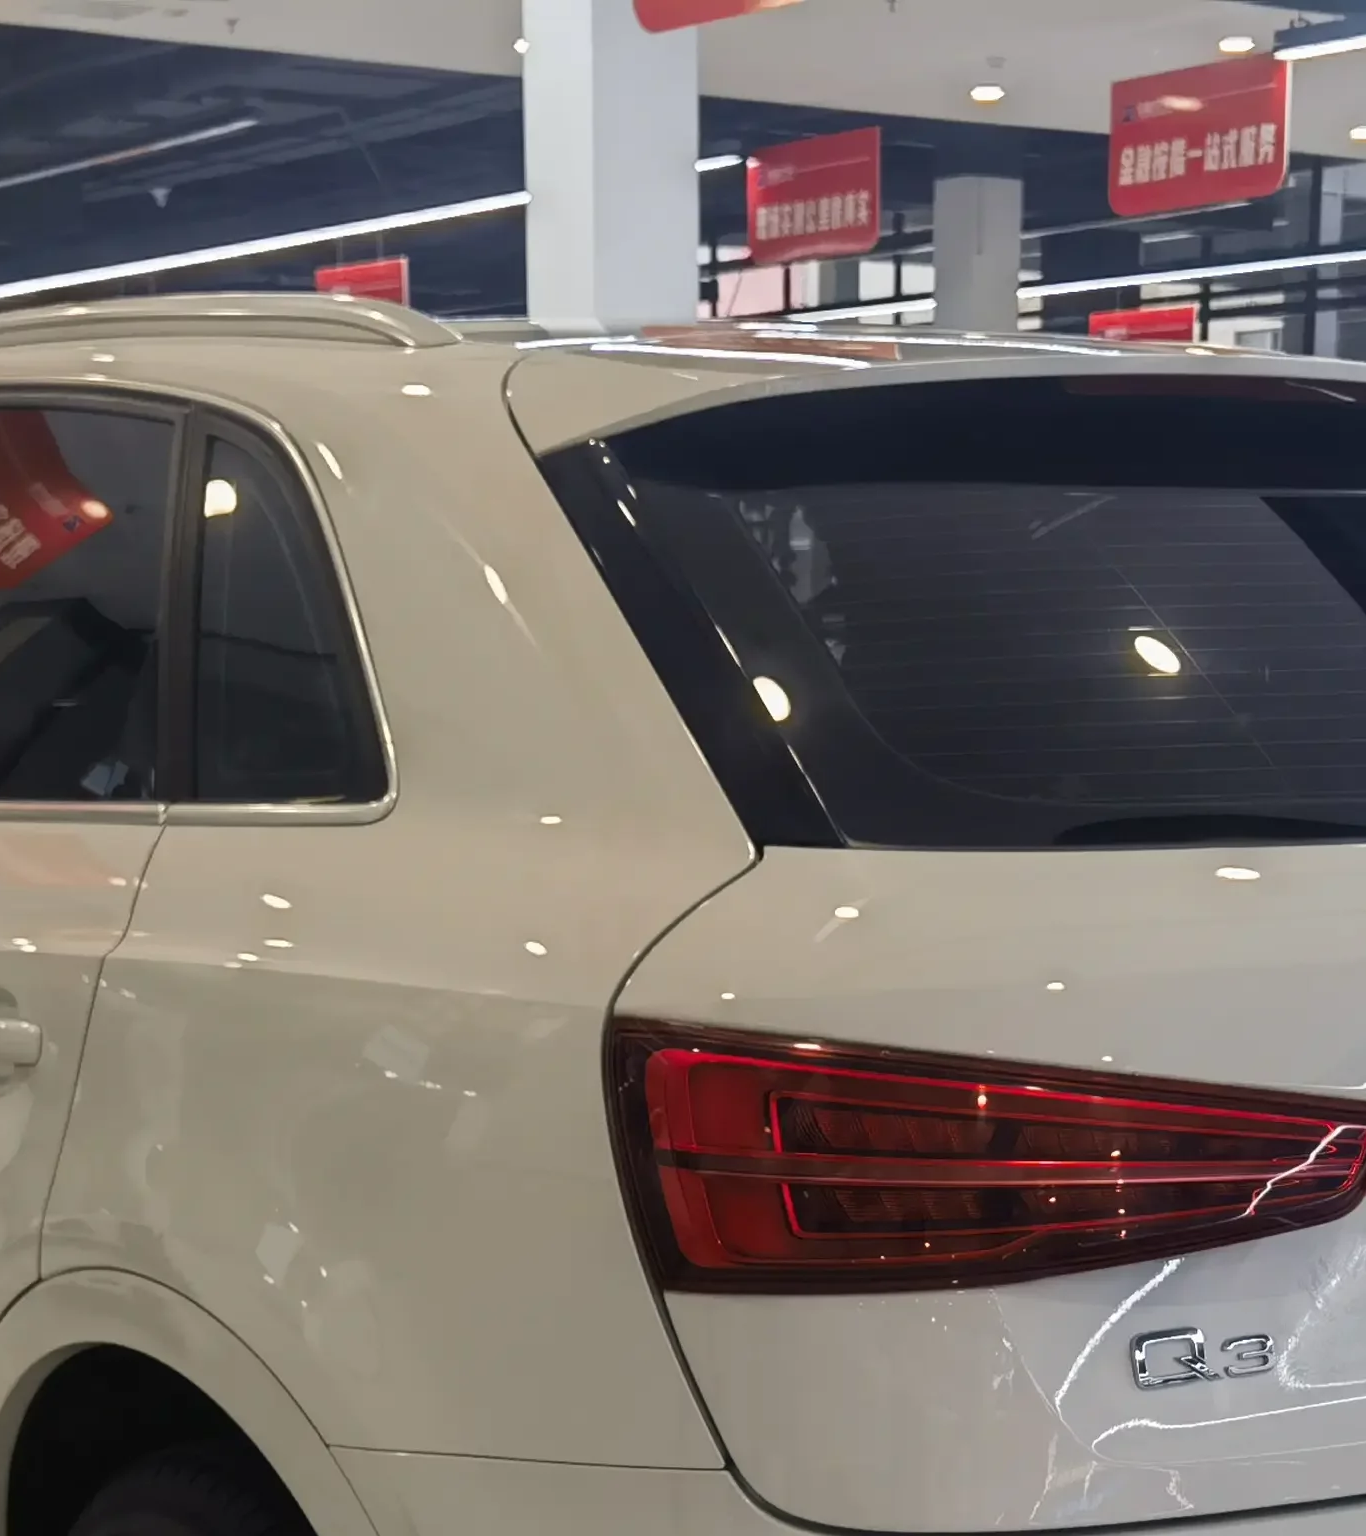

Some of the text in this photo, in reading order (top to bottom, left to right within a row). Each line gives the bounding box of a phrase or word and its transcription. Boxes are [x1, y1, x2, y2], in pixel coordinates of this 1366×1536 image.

[1118, 123, 1277, 186] 金融按揭一站式服务
[1130, 1326, 1276, 1391] Q3
